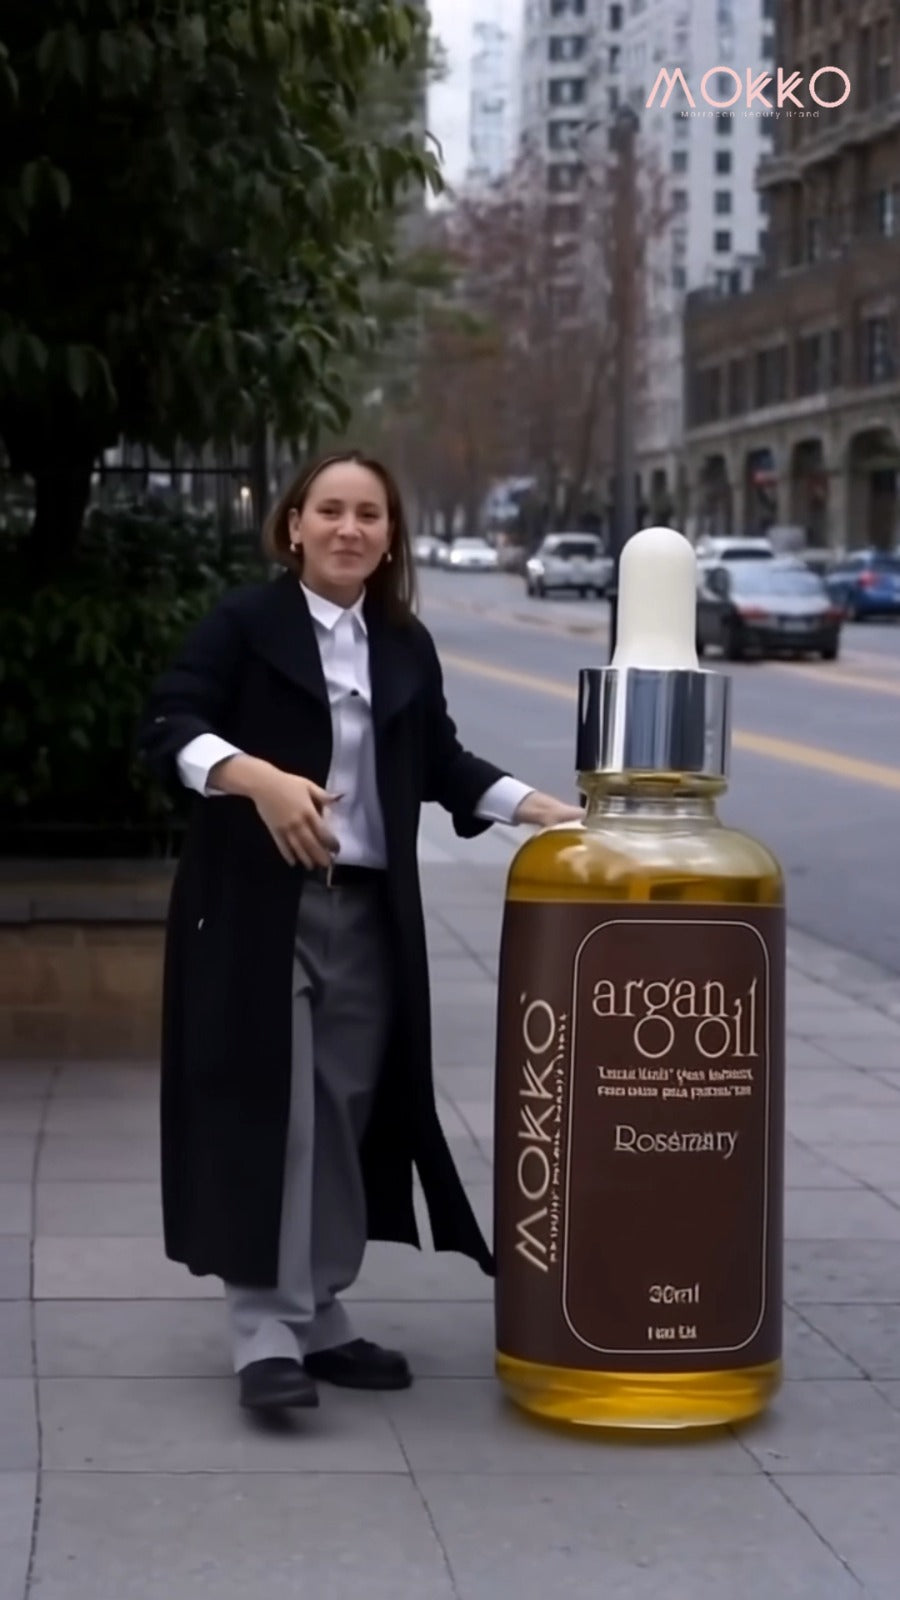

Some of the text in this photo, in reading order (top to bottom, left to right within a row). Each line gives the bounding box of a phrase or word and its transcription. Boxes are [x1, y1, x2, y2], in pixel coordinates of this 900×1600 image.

[592, 977, 729, 1059] argan
[694, 976, 759, 1057] oil
[515, 999, 556, 1273] MOKKO
